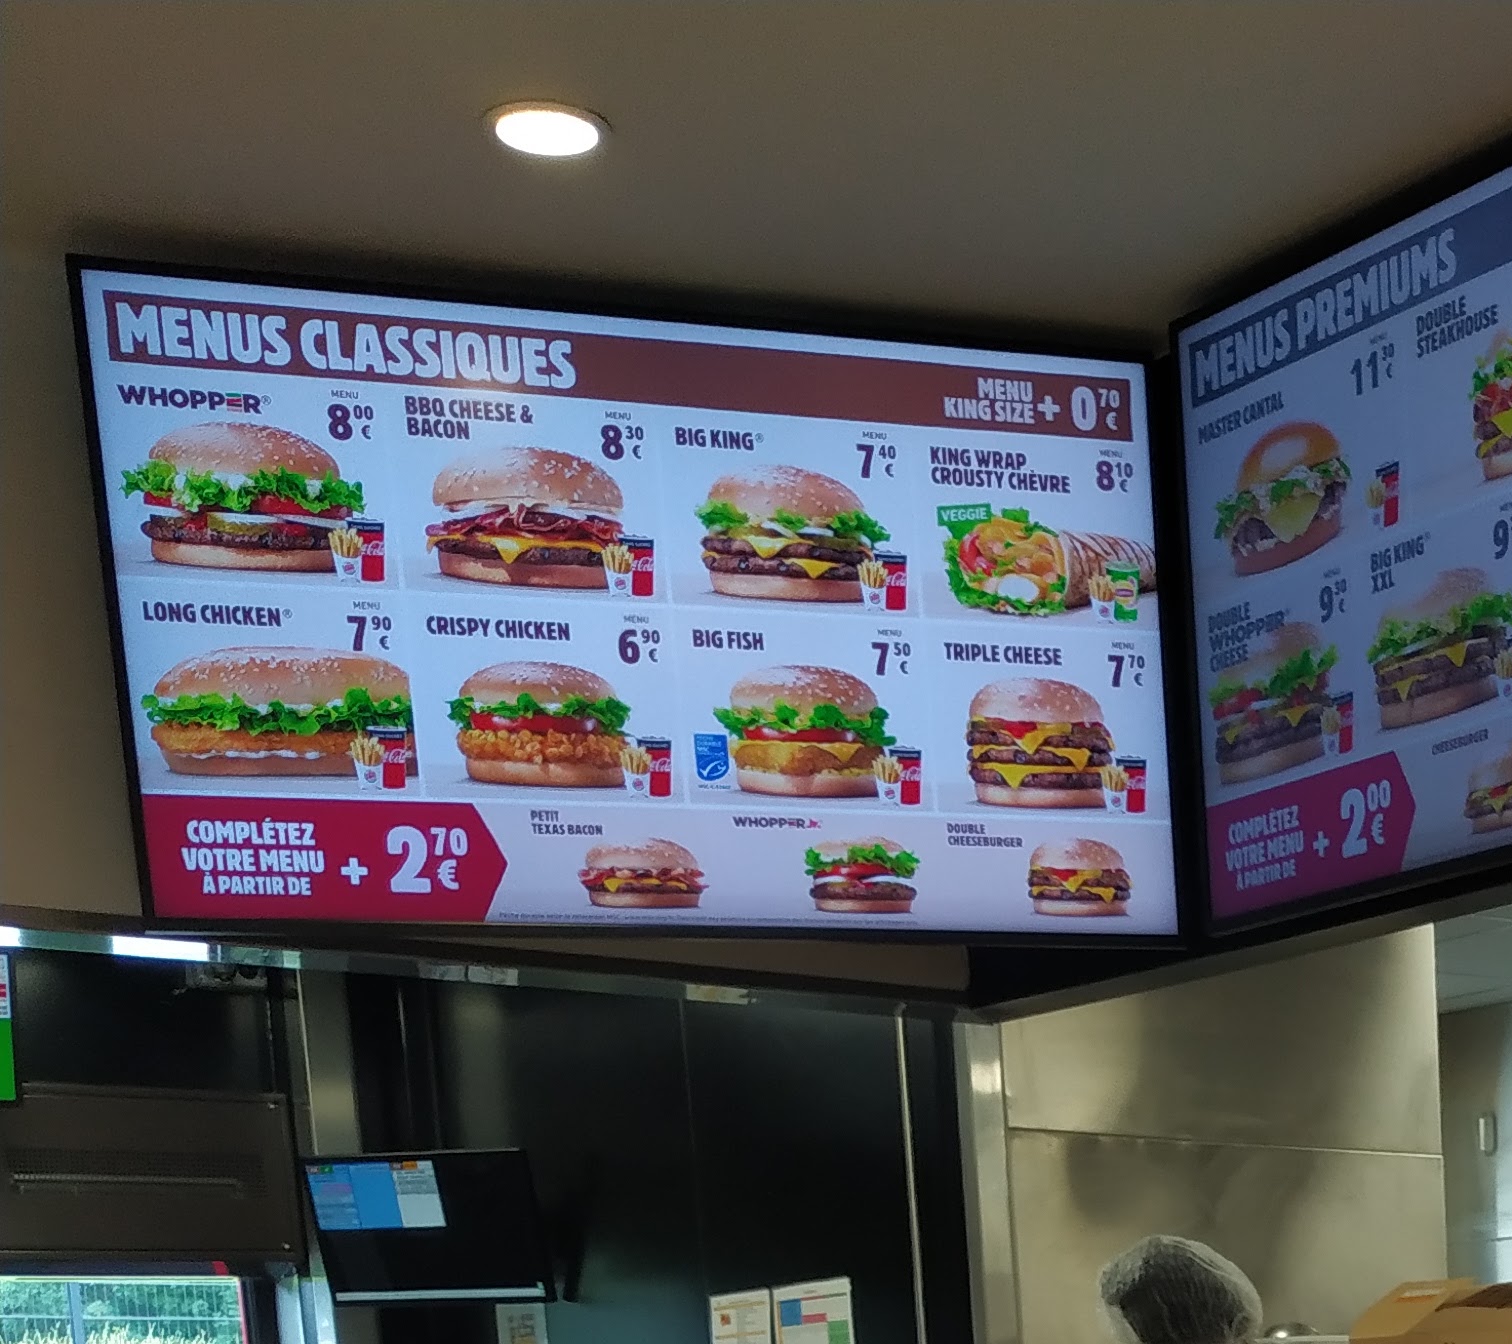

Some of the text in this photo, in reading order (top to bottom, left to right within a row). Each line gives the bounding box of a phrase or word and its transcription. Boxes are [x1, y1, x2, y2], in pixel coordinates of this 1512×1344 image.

[1196, 228, 1458, 397] MENUS PREMIUMS
[1415, 295, 1467, 337] DOUBLE
[1416, 304, 1499, 358] STEAKHOUSE
[116, 302, 577, 389] MENUS CLASSIQUES
[331, 389, 359, 399] MENU
[977, 377, 1034, 404] MENU
[405, 396, 533, 424] BBQ CHEESE &
[605, 410, 632, 421] MENU
[944, 396, 1035, 425] KING SIZE
[1198, 391, 1284, 445] MASTER CANTAL
[407, 416, 470, 440] BACON
[675, 427, 707, 449] BIG
[929, 446, 1028, 471] KING WRAP
[931, 467, 1071, 493] CROUSTY CHÈVRE
[941, 505, 990, 522] VEGGIE
[1370, 548, 1394, 573] BIG
[1371, 575, 1395, 594] XXL
[142, 602, 197, 624] LONG
[353, 601, 380, 610] MENU
[1208, 602, 1251, 633] DOUBLE
[427, 616, 571, 641] CRISPY CHICKEN
[624, 615, 649, 624] MENU
[692, 629, 765, 651] BIG FISH
[943, 643, 1063, 666] TRIPLE CHEESE
[1210, 644, 1248, 672] CHEESE
[1431, 729, 1489, 755] CHEESEBURGER
[530, 810, 560, 823] PETIT
[947, 823, 986, 835] DOUBLE
[1228, 805, 1300, 843] COMPLÉTEZ
[186, 817, 316, 846] COMPLÉTEZ
[532, 823, 603, 836] TEXAS BACON
[947, 835, 1023, 849] CHEESEBURGER
[182, 848, 325, 874] VOTRE MENU
[1226, 831, 1304, 872] VOTRE MENU
[1282, 859, 1296, 878] DE
[203, 874, 311, 896] À PARTIR DE
